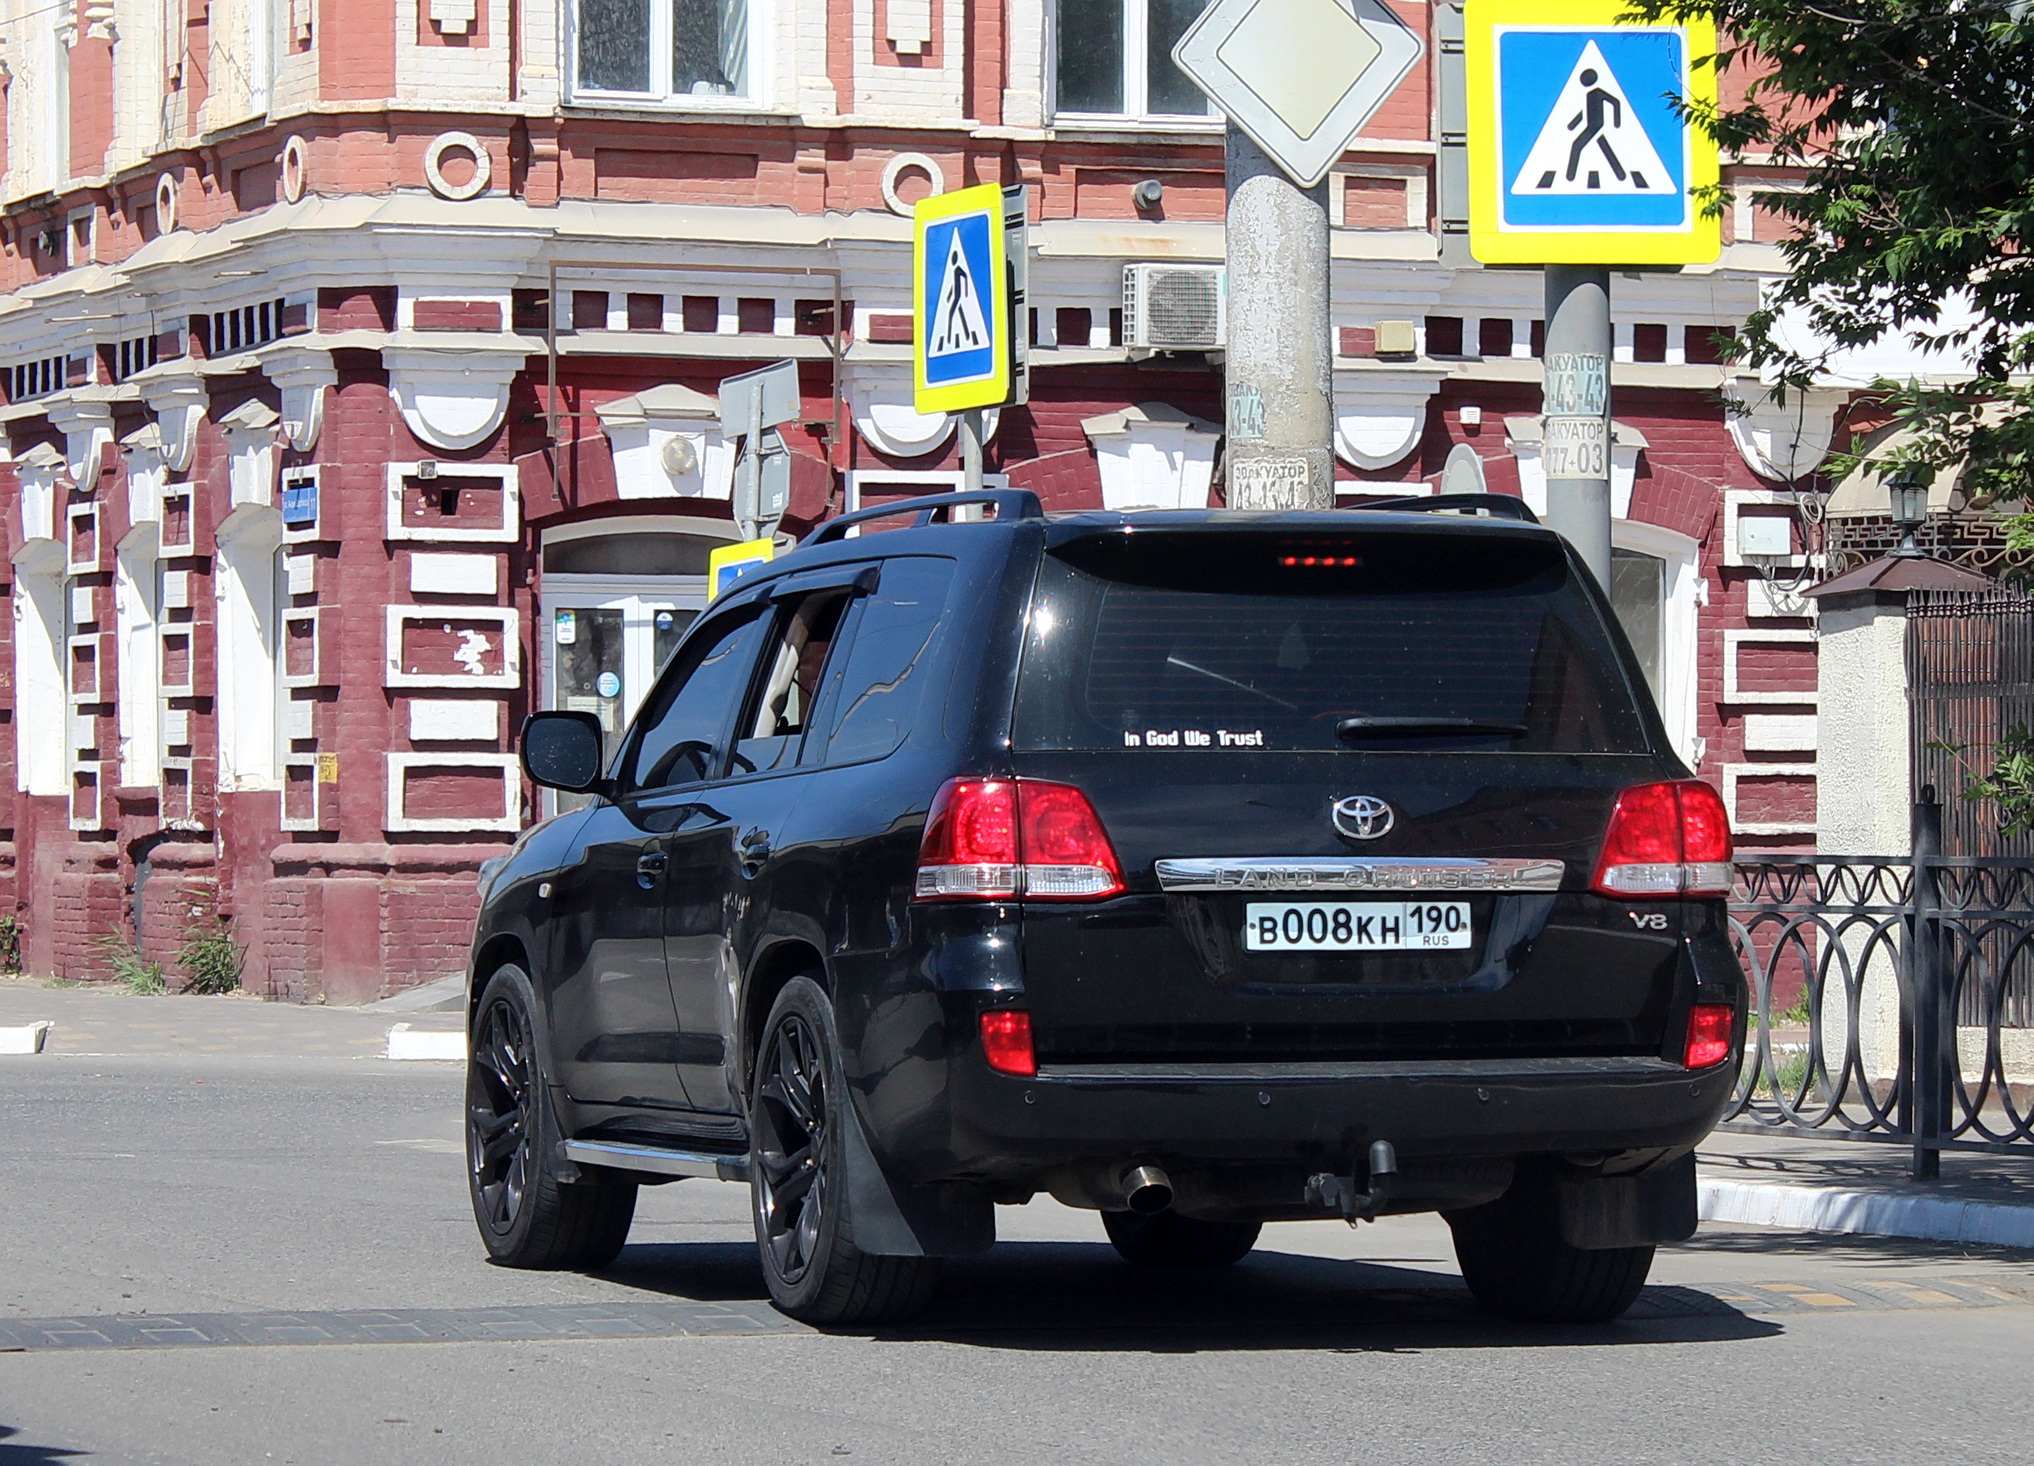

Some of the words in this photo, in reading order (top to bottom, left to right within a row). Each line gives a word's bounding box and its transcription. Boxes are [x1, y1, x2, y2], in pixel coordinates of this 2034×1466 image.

[1124, 730, 1141, 747] In
[1146, 730, 1179, 747] God
[1184, 730, 1211, 747] We
[1216, 730, 1264, 747] Trust
[1214, 867, 1316, 889] LAND
[1344, 866, 1513, 889] CRUISER
[1258, 907, 1400, 945] В008КН
[1408, 904, 1461, 933] 190
[1628, 911, 1668, 930] V8
[1422, 935, 1450, 946] RUS
